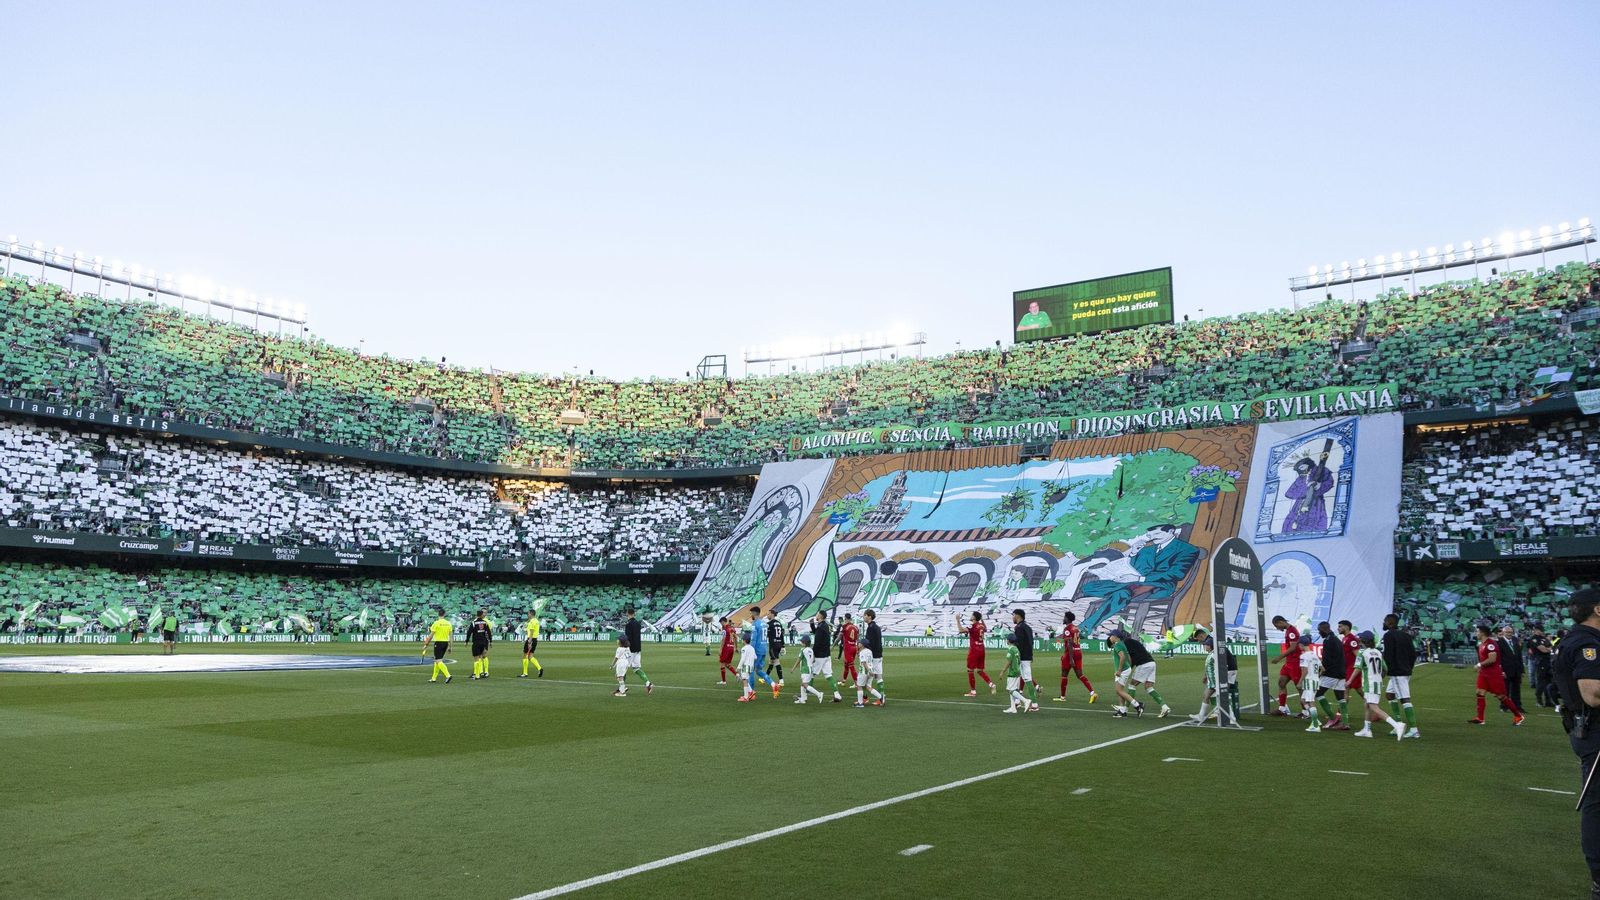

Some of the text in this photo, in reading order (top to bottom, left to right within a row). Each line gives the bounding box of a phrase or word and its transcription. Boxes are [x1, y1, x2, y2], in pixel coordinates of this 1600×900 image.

[1073, 302, 1078, 310] y
[1090, 299, 1104, 308] que
[1118, 294, 1132, 302] hay
[1133, 290, 1156, 301] quien
[1072, 310, 1096, 320] pueda
[1112, 305, 1130, 314] esta
[1131, 300, 1158, 311] afición
[1070, 403, 1222, 434] IDIOSINCRASIA
[1231, 403, 1245, 420] Y
[1251, 386, 1394, 419] SEVILLANÍA
[112, 414, 168, 430] BETIS
[43, 536, 74, 545] hummel
[120, 540, 158, 550] Cruzcampo
[1228, 548, 1252, 570] finetwork
[774, 626, 781, 638] 13
